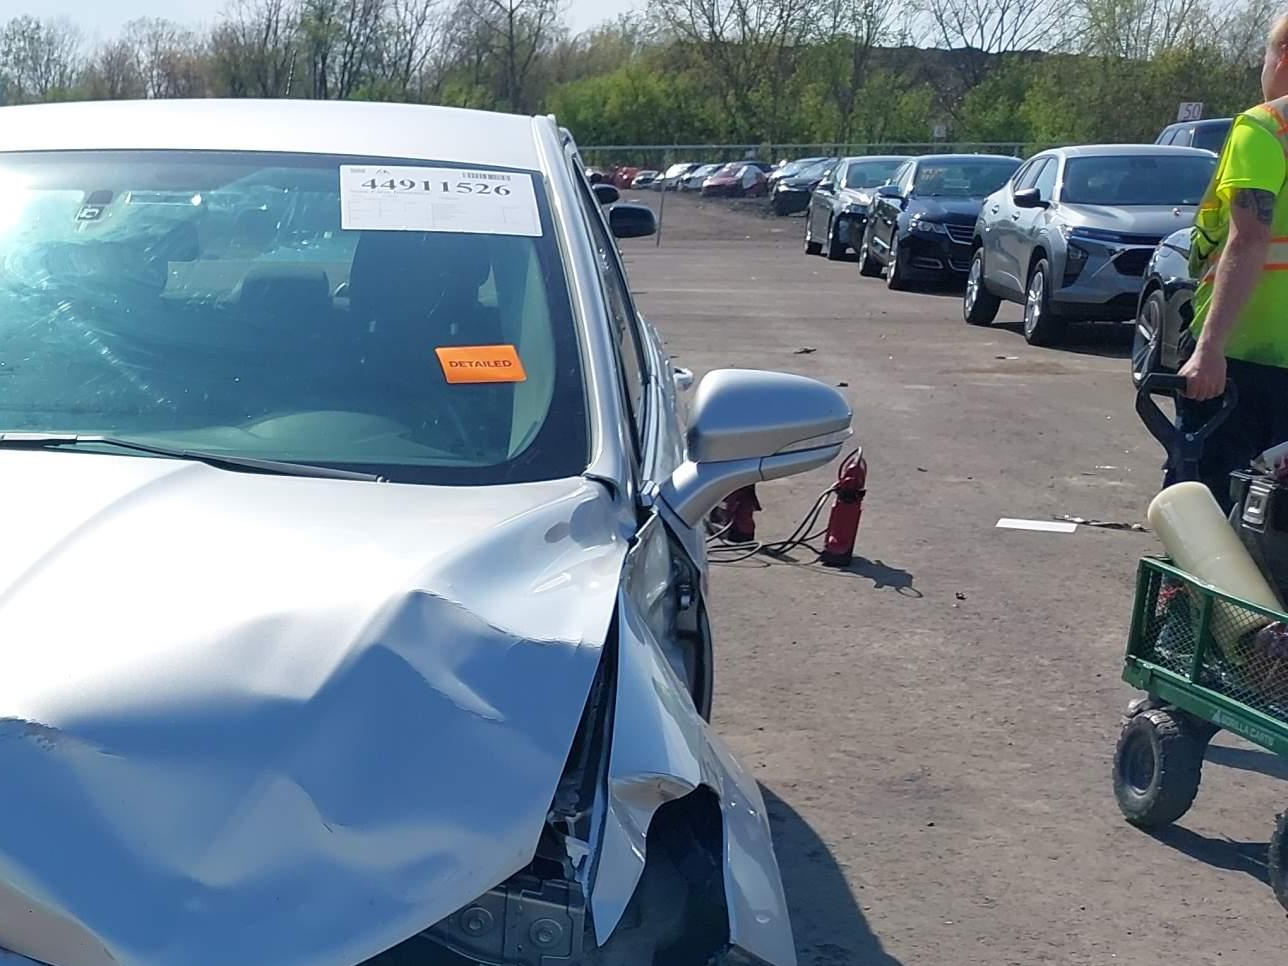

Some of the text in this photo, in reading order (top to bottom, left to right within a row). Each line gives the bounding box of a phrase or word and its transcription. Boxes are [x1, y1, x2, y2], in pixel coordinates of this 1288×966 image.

[1183, 103, 1201, 119] 50
[361, 178, 511, 196] 44911526
[449, 360, 512, 368] DETAILED
